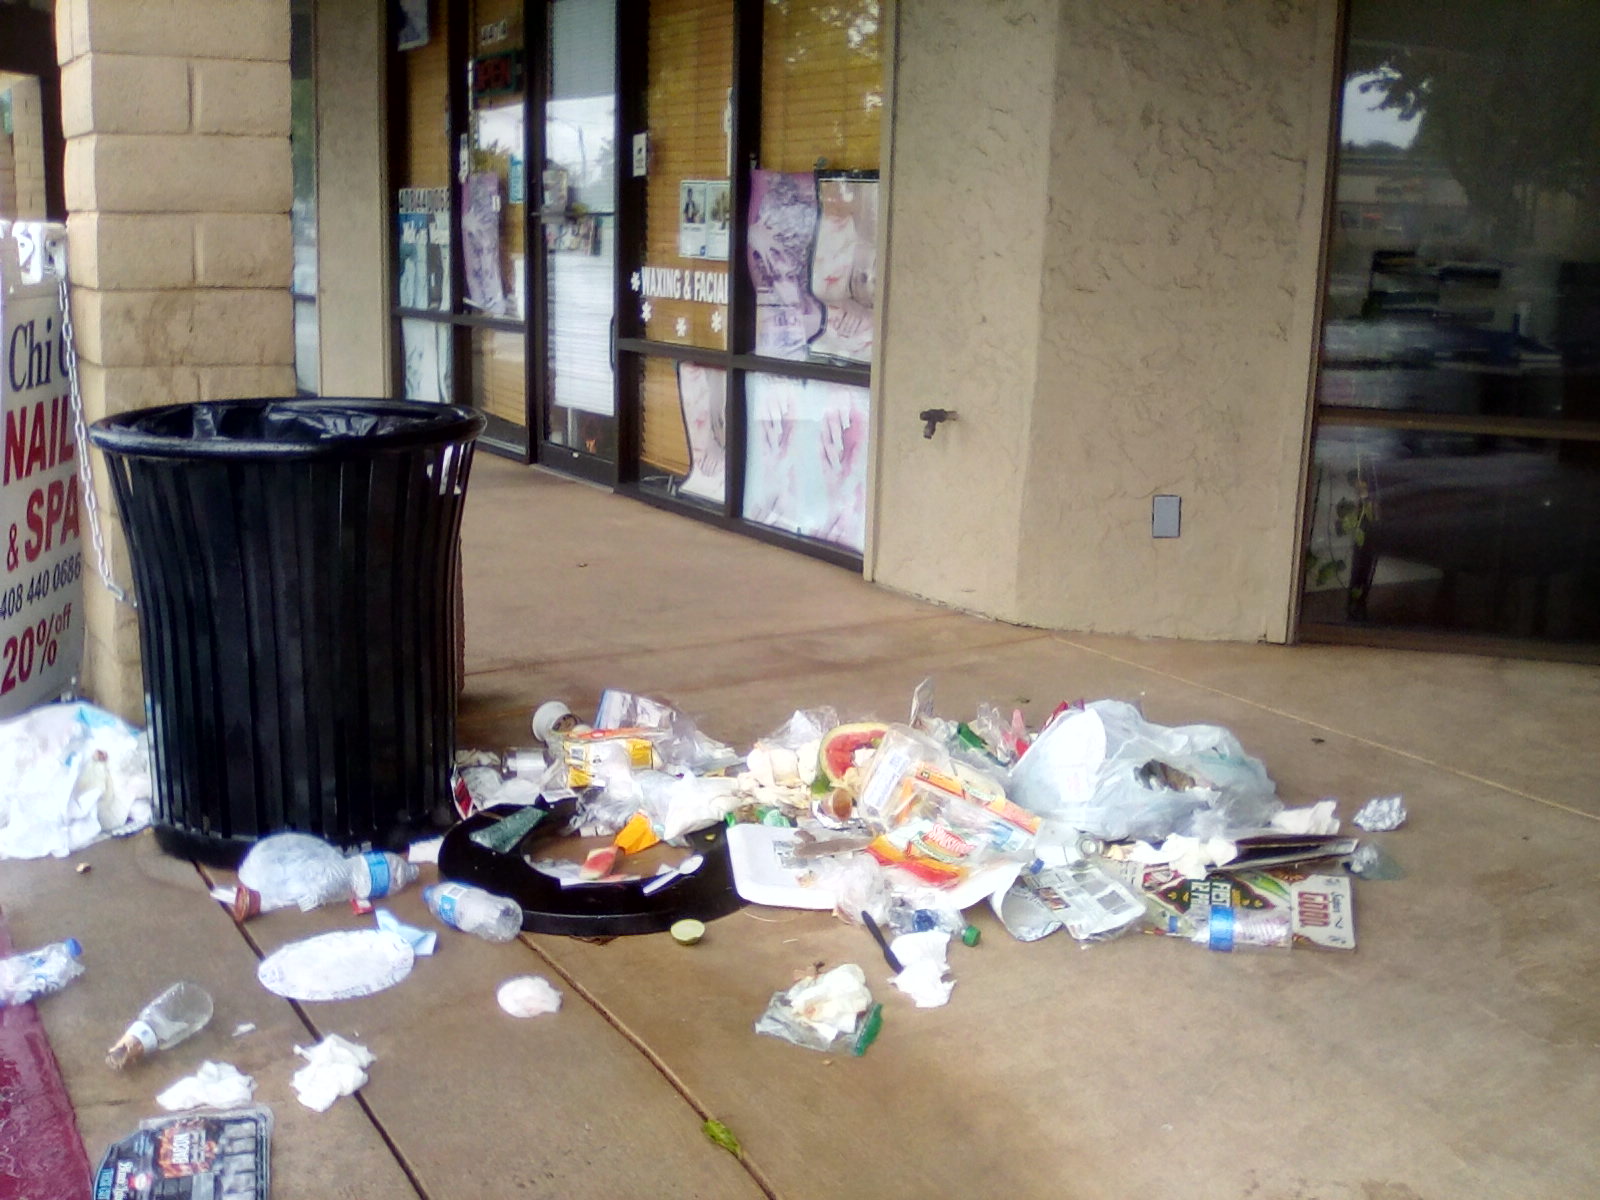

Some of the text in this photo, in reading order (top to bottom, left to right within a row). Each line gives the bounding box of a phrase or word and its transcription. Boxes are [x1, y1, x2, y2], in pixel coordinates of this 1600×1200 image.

[641, 266, 681, 299] WAXING
[683, 270, 692, 300] &
[9, 316, 52, 392] Chi
[3, 394, 74, 486] NAIL
[7, 474, 80, 572] & SPA
[0, 552, 82, 620] 408 440 0686
[0, 602, 72, 696] 20% off
